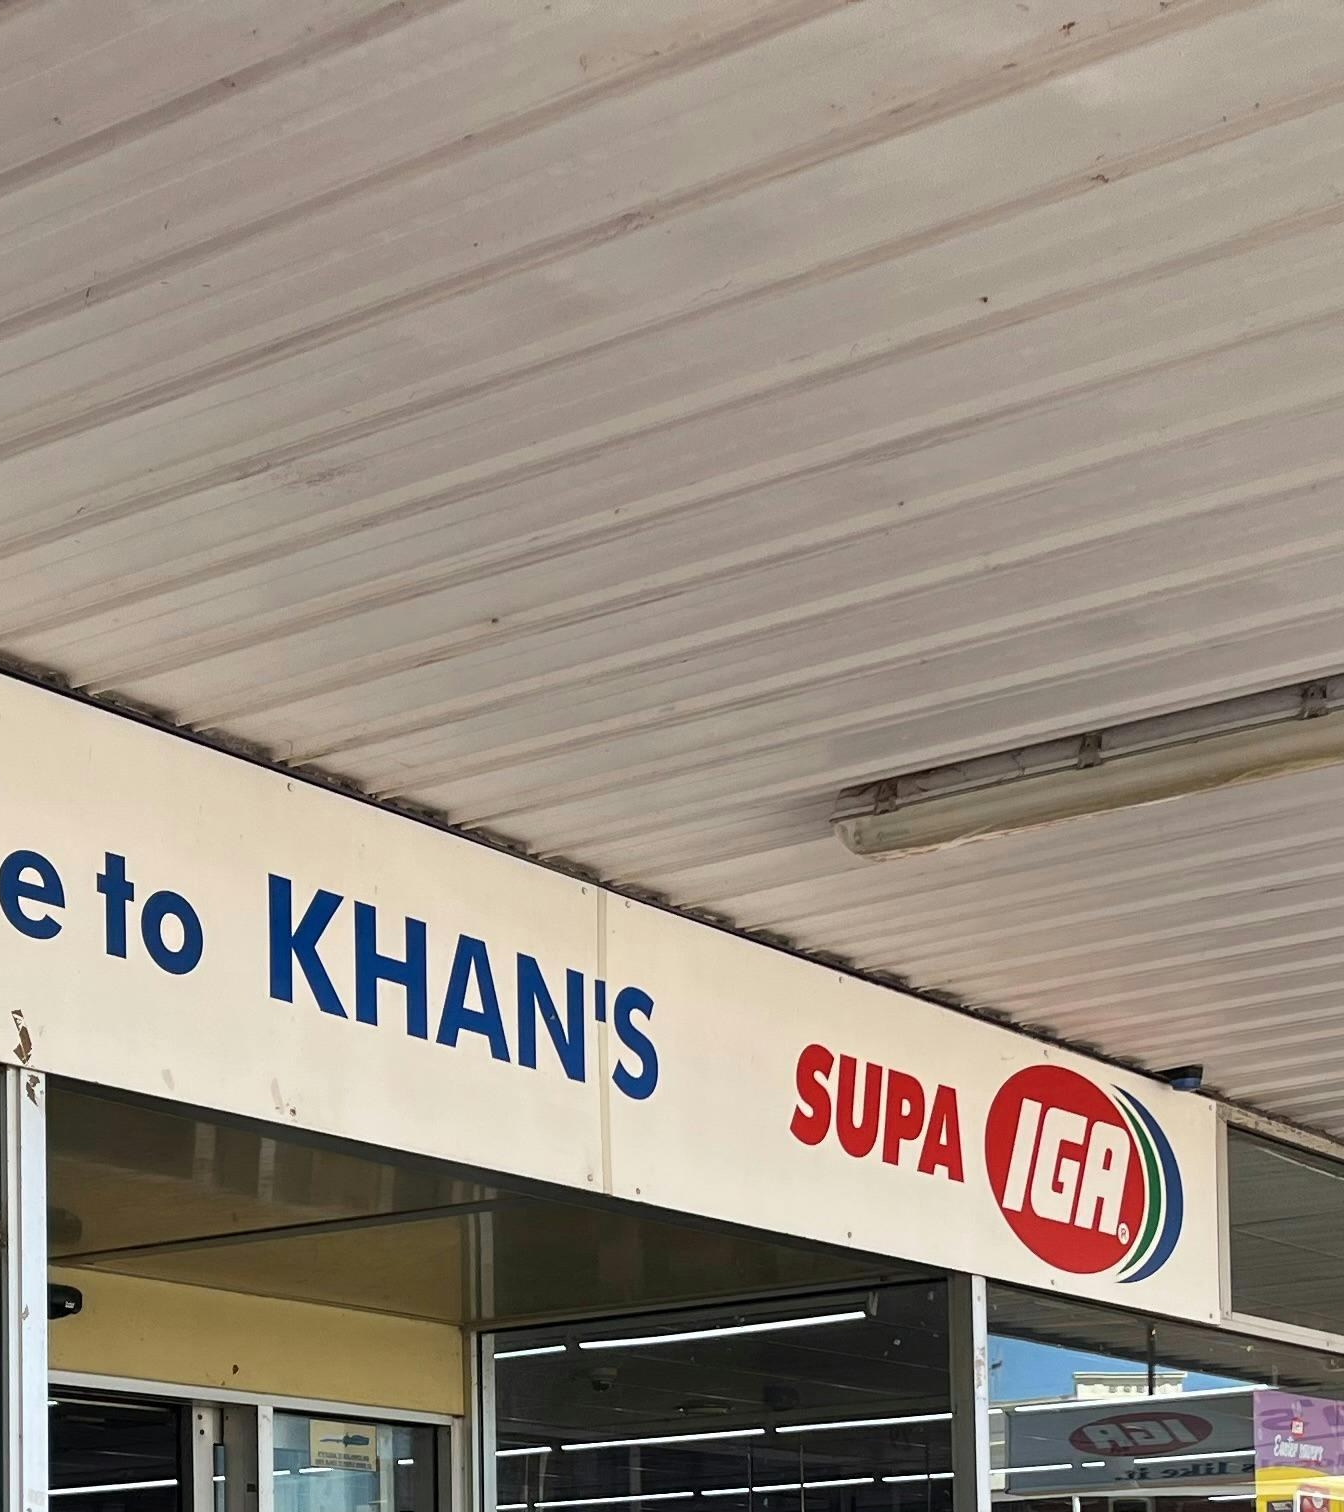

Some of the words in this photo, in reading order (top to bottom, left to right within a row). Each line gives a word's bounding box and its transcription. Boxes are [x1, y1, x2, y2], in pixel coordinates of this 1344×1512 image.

[96, 851, 204, 975] to
[267, 873, 658, 1100] KHAN'S
[790, 1043, 965, 1182] SUPA
[1001, 1097, 1131, 1236] IGA
